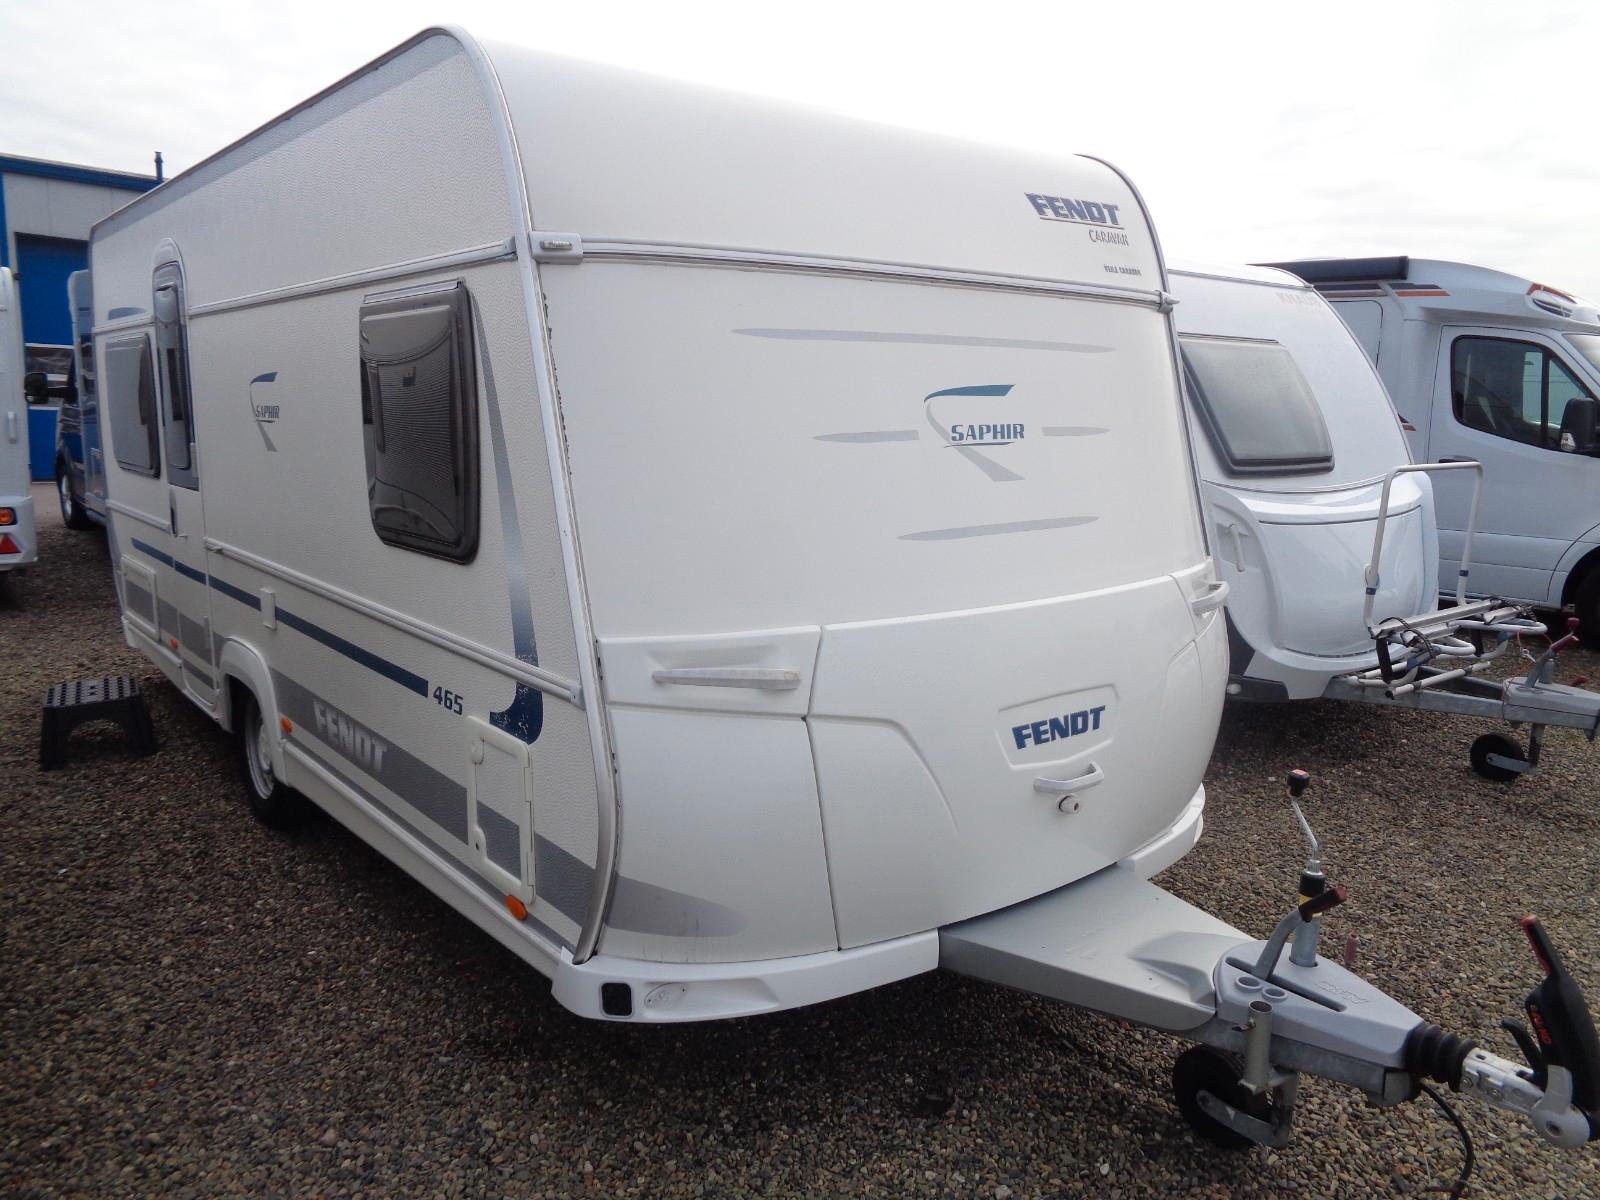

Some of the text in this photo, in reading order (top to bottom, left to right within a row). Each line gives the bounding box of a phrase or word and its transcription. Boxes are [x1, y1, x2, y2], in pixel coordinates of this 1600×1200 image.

[1024, 192, 1119, 225] FENDT
[1088, 229, 1129, 246] CARAVAN
[255, 404, 280, 419] SAPHIR
[950, 423, 1025, 442] SAPHIR
[432, 686, 464, 716] 465
[312, 699, 387, 774] FENDT
[1011, 705, 1106, 750] FENDT
